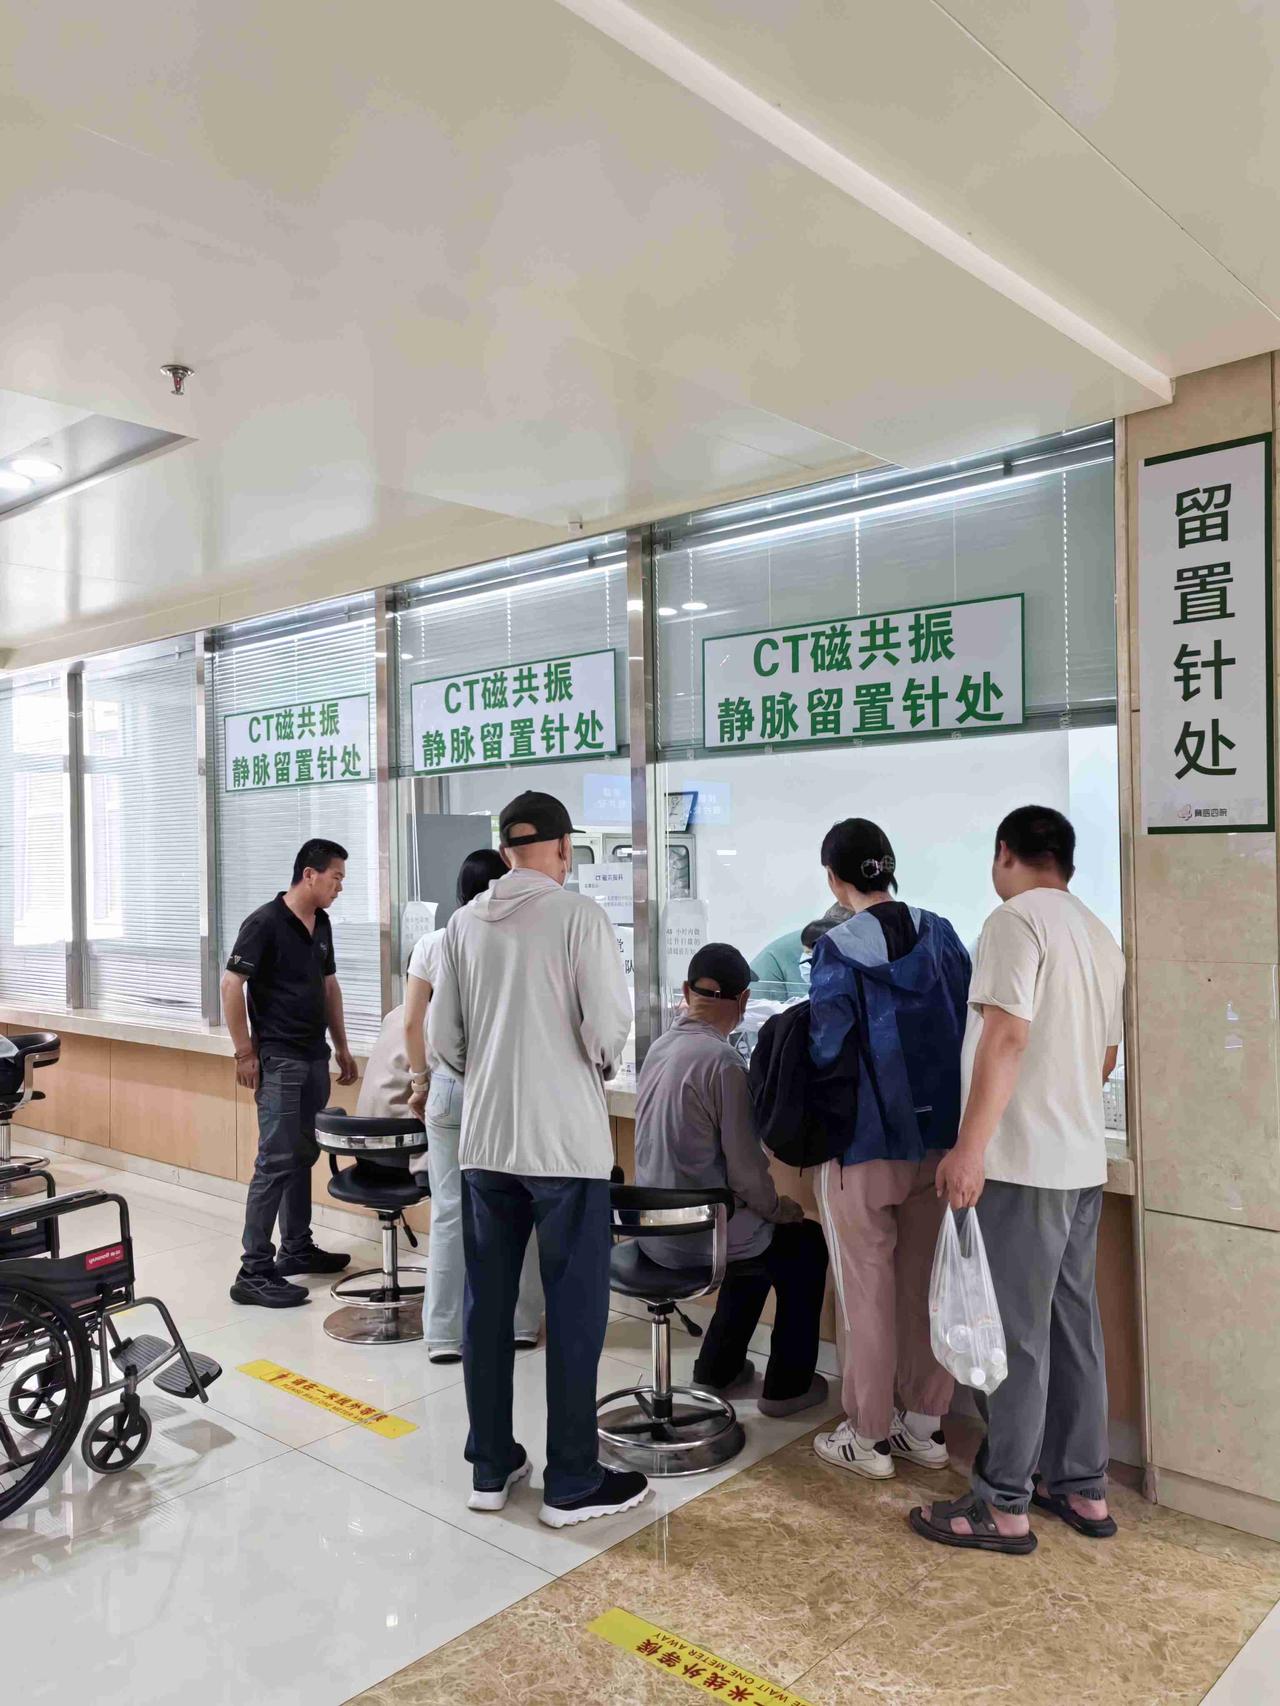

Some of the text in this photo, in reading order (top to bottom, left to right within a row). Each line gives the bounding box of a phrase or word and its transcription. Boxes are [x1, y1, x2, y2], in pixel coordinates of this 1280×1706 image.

[752, 610, 956, 677] CT磁共振
[1172, 482, 1238, 780] 留置针处
[444, 662, 574, 714] CT磁共振
[717, 670, 1004, 743] 静脉留置针处
[248, 702, 340, 743] CT磁共振
[421, 709, 605, 768] 静脉留置针处
[231, 743, 362, 788] 静脉留置针处
[653, 1631, 789, 1703] WAIT ONE METER AWAY
